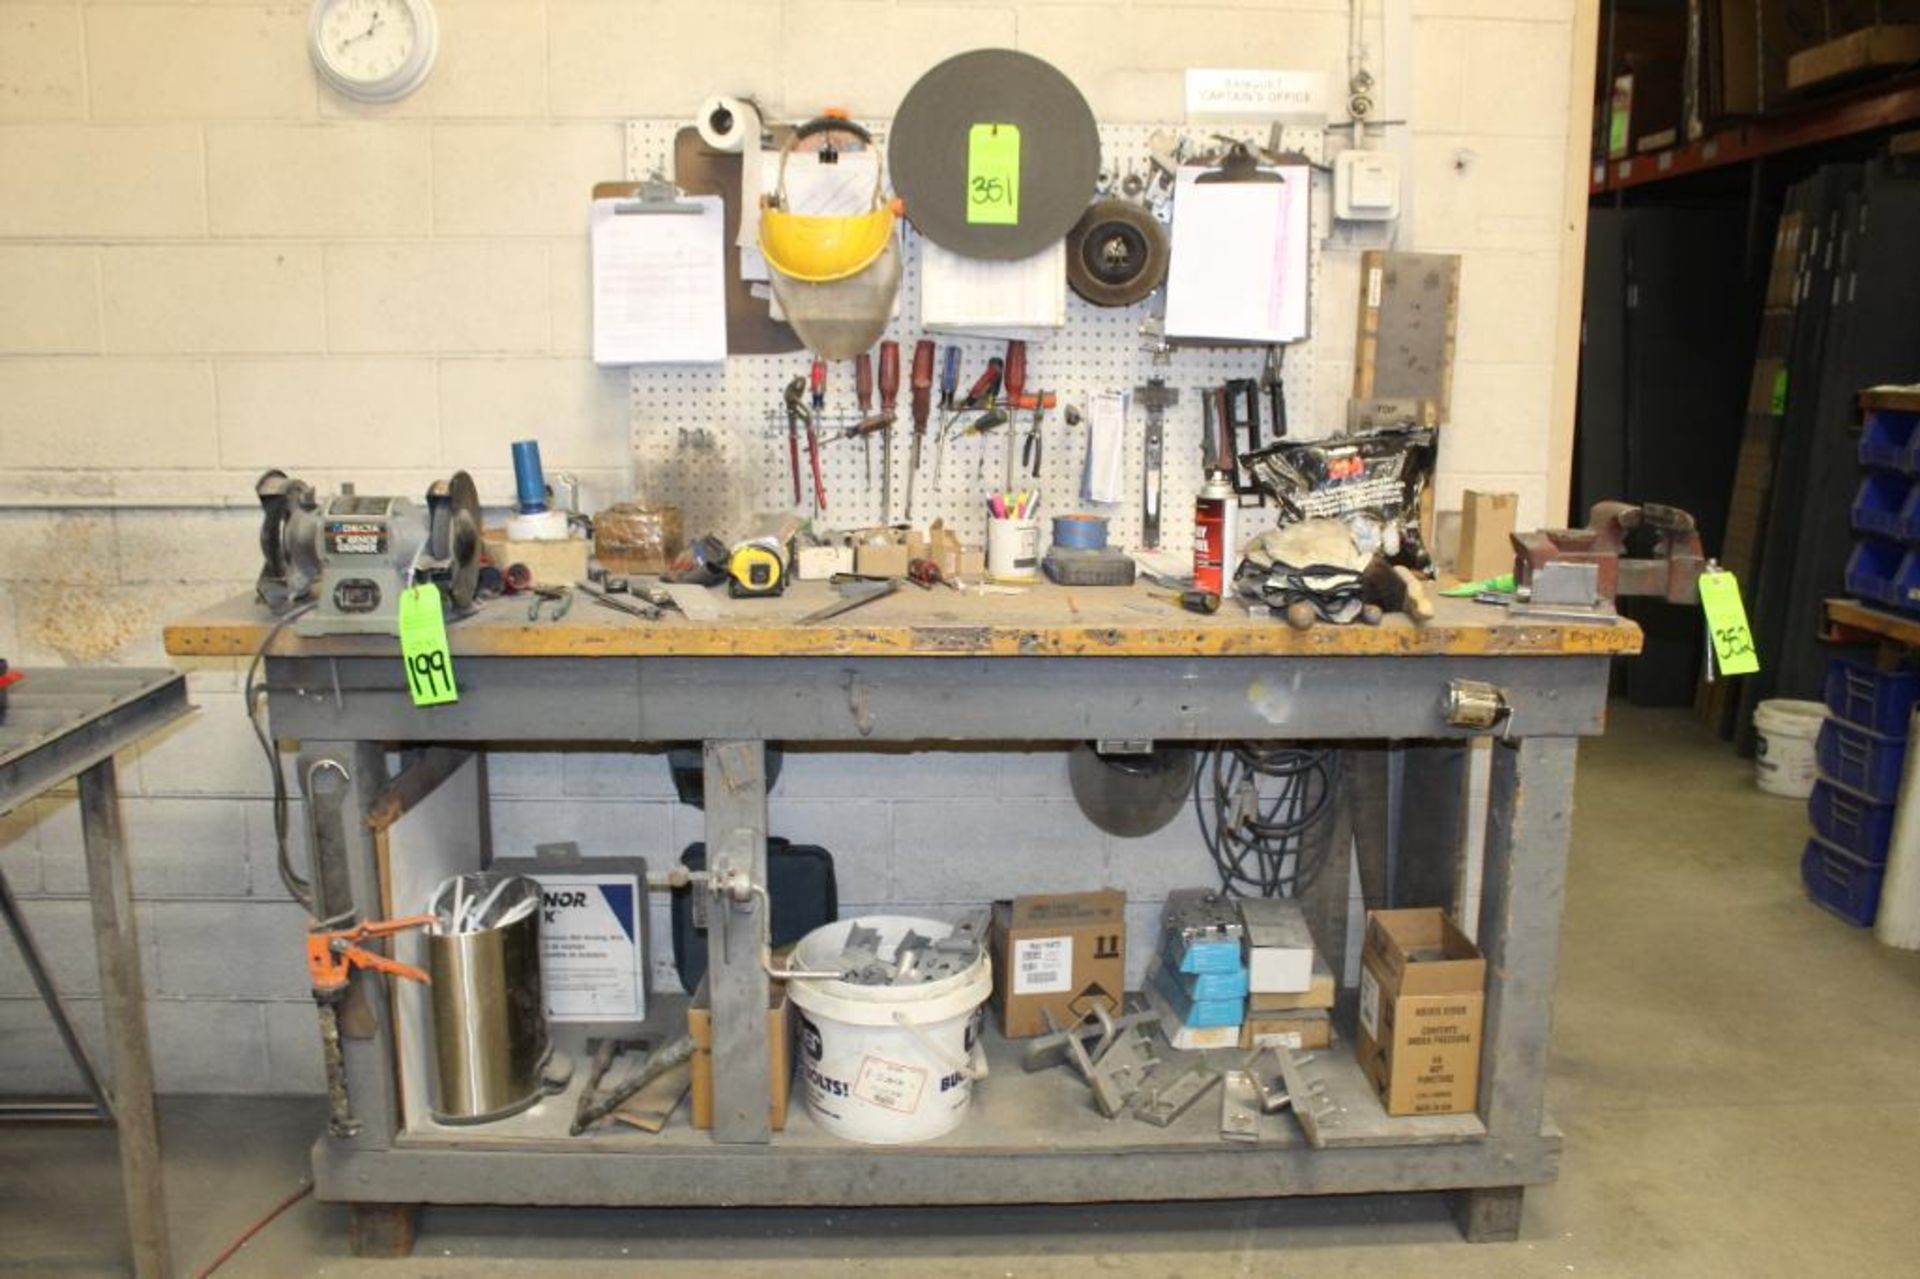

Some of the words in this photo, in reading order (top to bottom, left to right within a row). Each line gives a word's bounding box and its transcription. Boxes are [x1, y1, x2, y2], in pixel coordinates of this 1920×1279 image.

[1199, 90, 1265, 102] CAPTAIN'S
[1267, 90, 1311, 103] OFFICE
[972, 174, 1013, 206] 351
[1377, 404, 1397, 415] TOP
[408, 650, 452, 698] 199
[542, 892, 588, 908] NOR
